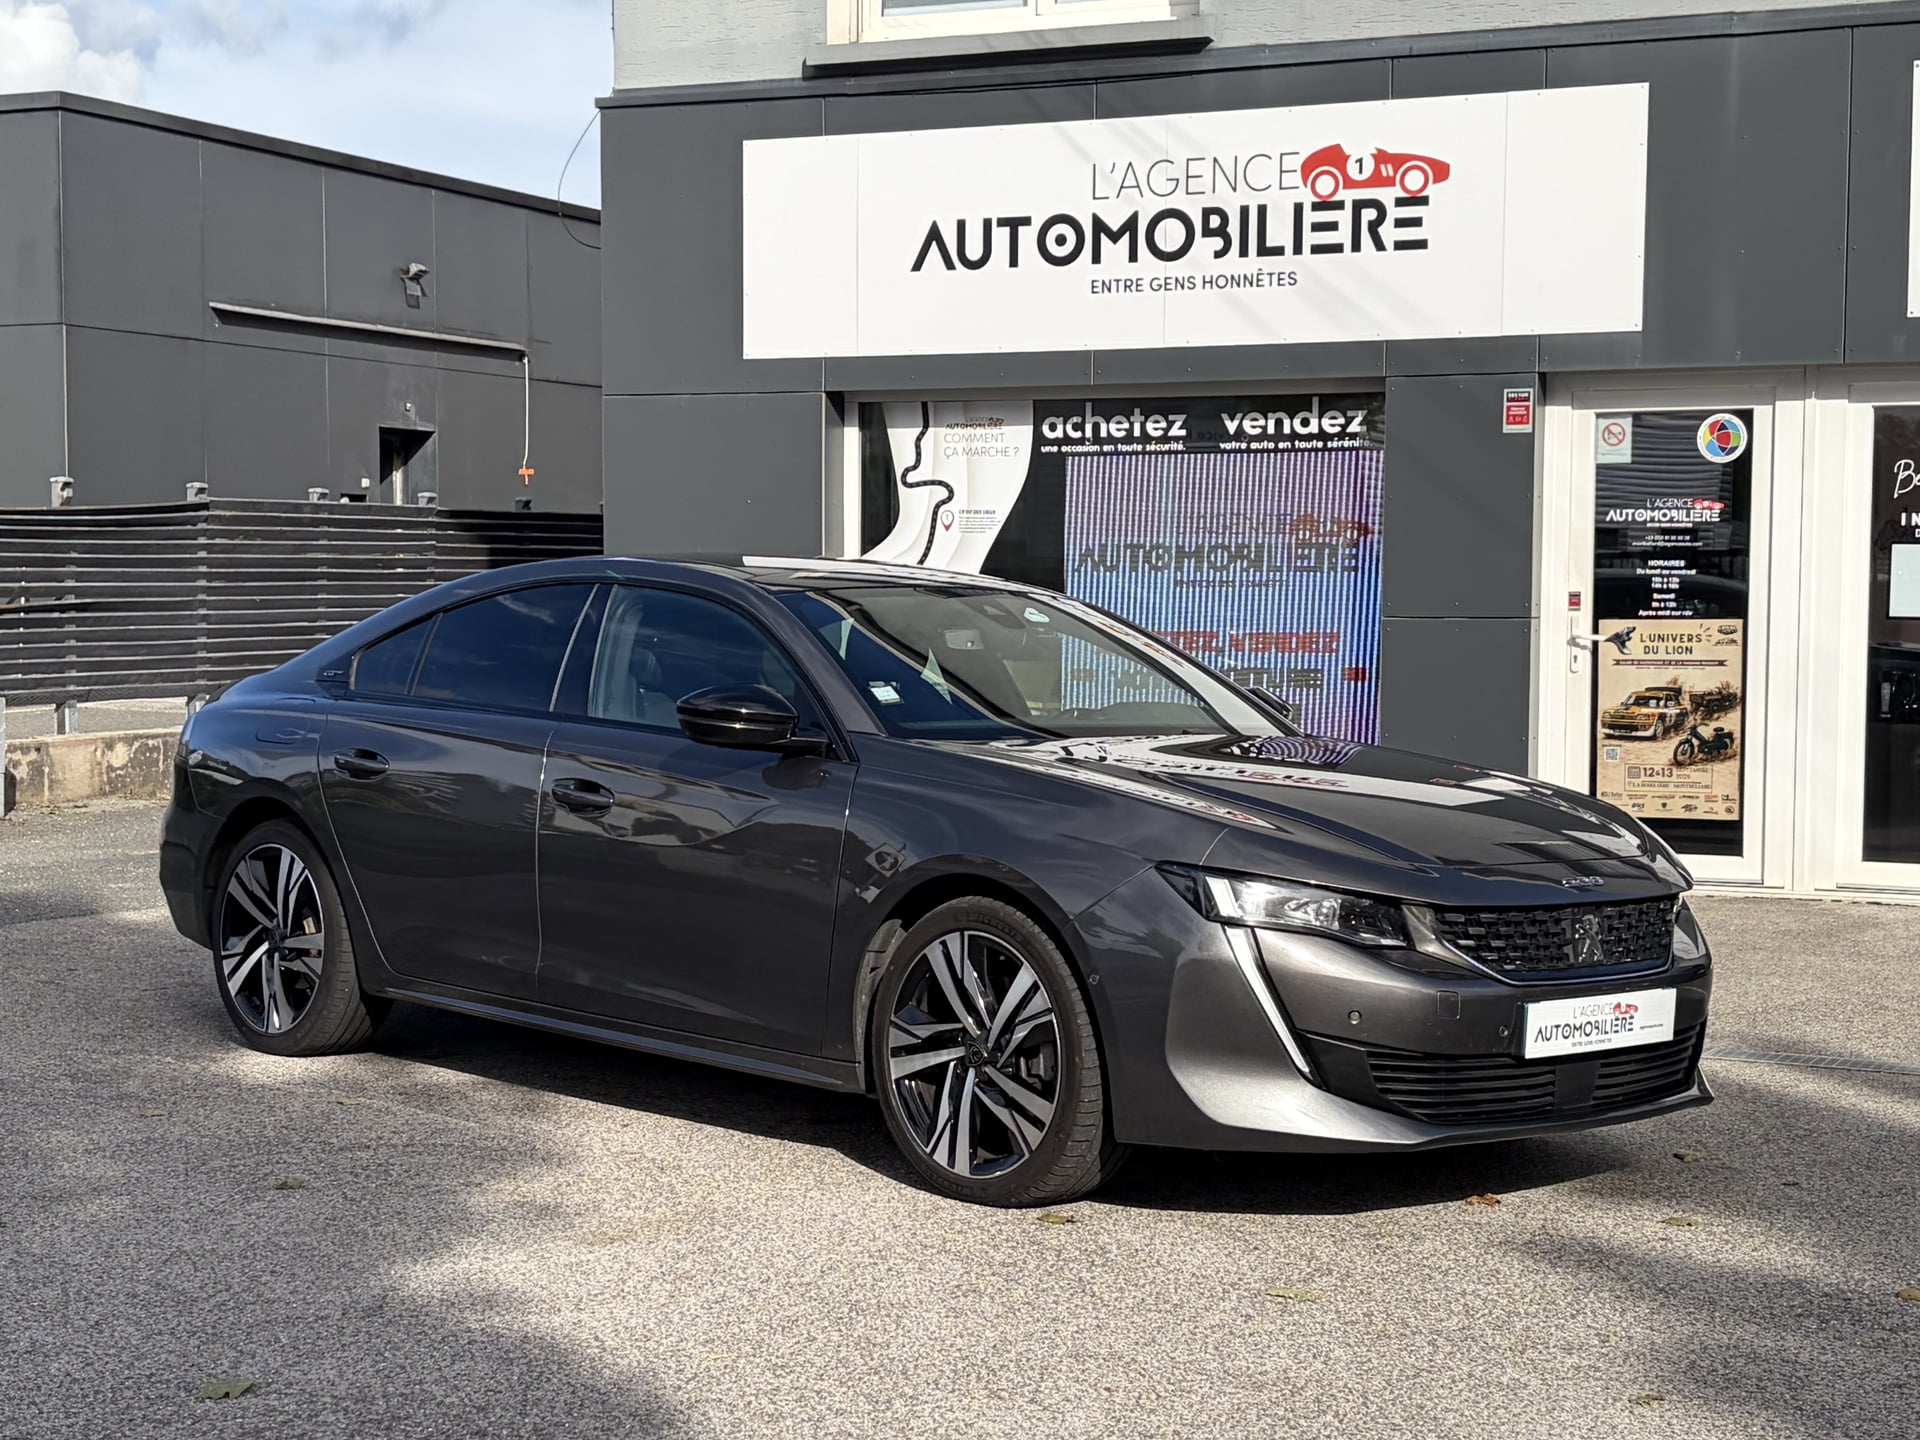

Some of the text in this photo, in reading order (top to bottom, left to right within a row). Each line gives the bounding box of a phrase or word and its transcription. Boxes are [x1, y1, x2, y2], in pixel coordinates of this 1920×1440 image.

[1354, 156, 1364, 175] 1
[1092, 151, 1300, 200] L'AGENCE
[1091, 268, 1298, 294] ENTRE GENS HONNÊTES
[1041, 401, 1187, 439] achetez
[1220, 396, 1368, 435] vendez
[944, 433, 1005, 443] COMMENT
[1219, 440, 1247, 450] votre
[1250, 440, 1275, 449] auto
[1278, 441, 1291, 449] en
[1294, 439, 1323, 448] toute
[943, 446, 1020, 460] ÇA MARCHE ?
[1041, 444, 1059, 453] une
[1061, 442, 1100, 452] occasion
[1103, 444, 1115, 452] en
[1117, 442, 1143, 451] toute
[1646, 498, 1693, 508] L'AGENCE
[1643, 646, 1693, 655] DU LION
[1573, 1002, 1613, 1019] L'AGENCE
